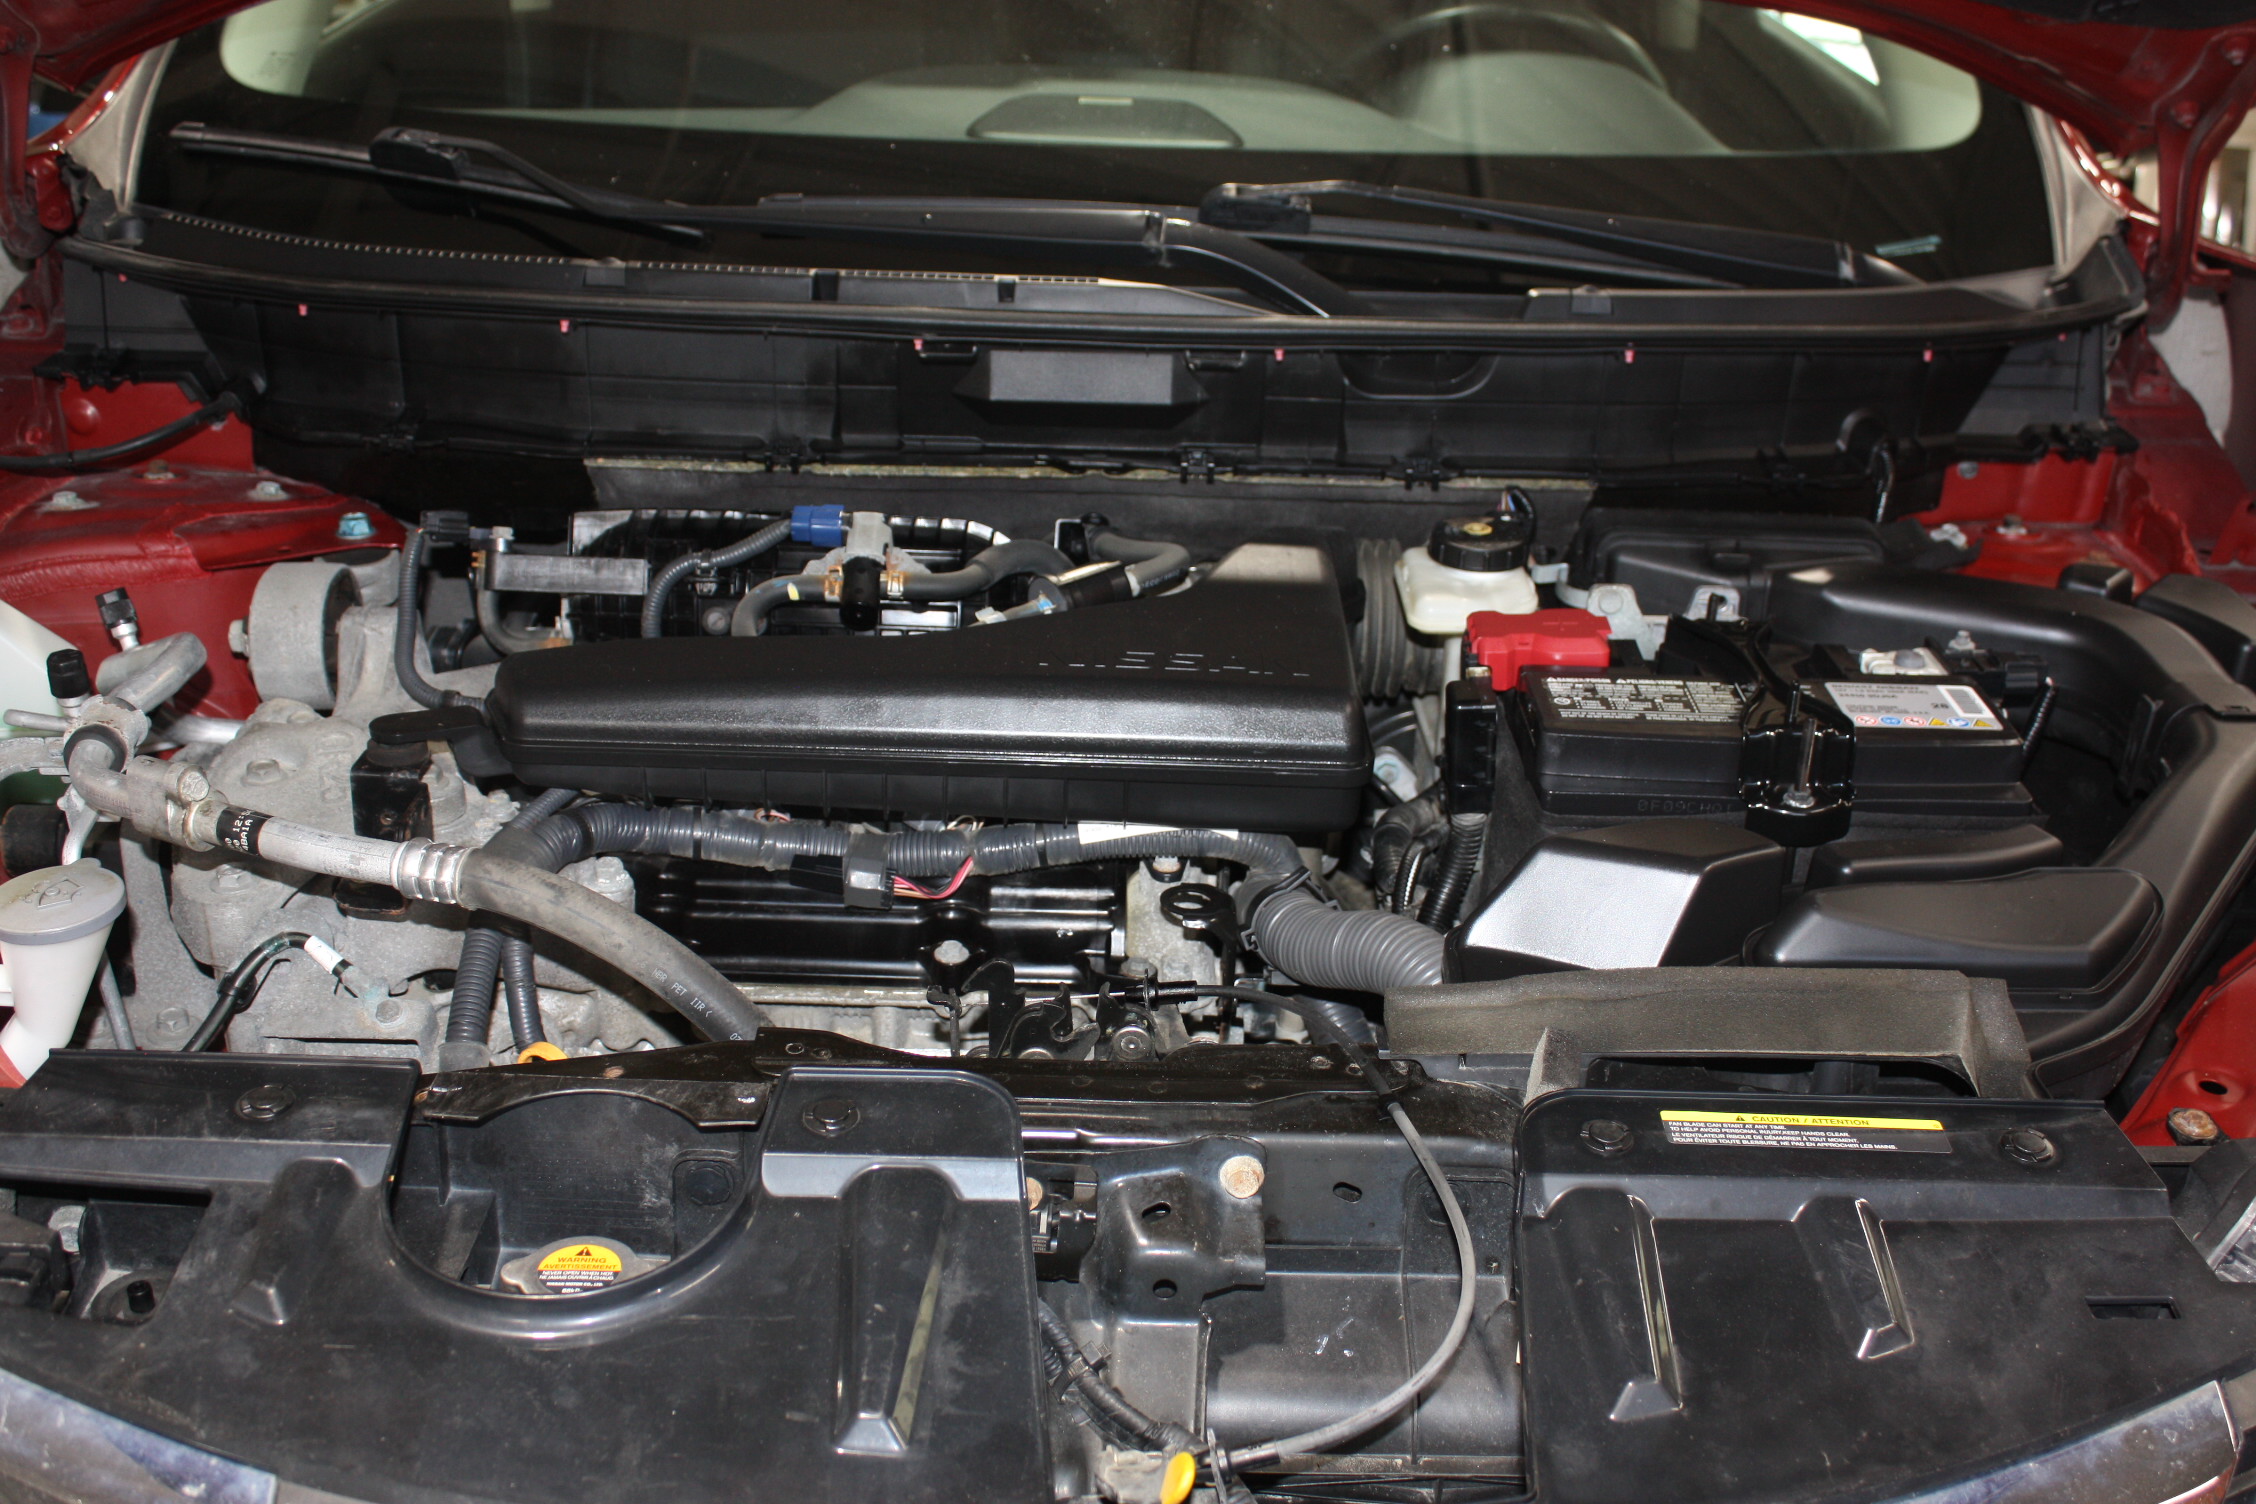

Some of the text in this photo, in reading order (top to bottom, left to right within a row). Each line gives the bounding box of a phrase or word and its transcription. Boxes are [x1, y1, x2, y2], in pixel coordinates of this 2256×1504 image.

[671, 982, 687, 996] PET
[1752, 1116, 1800, 1124] CAUTION
[1812, 1118, 1869, 1126] ATTENTION
